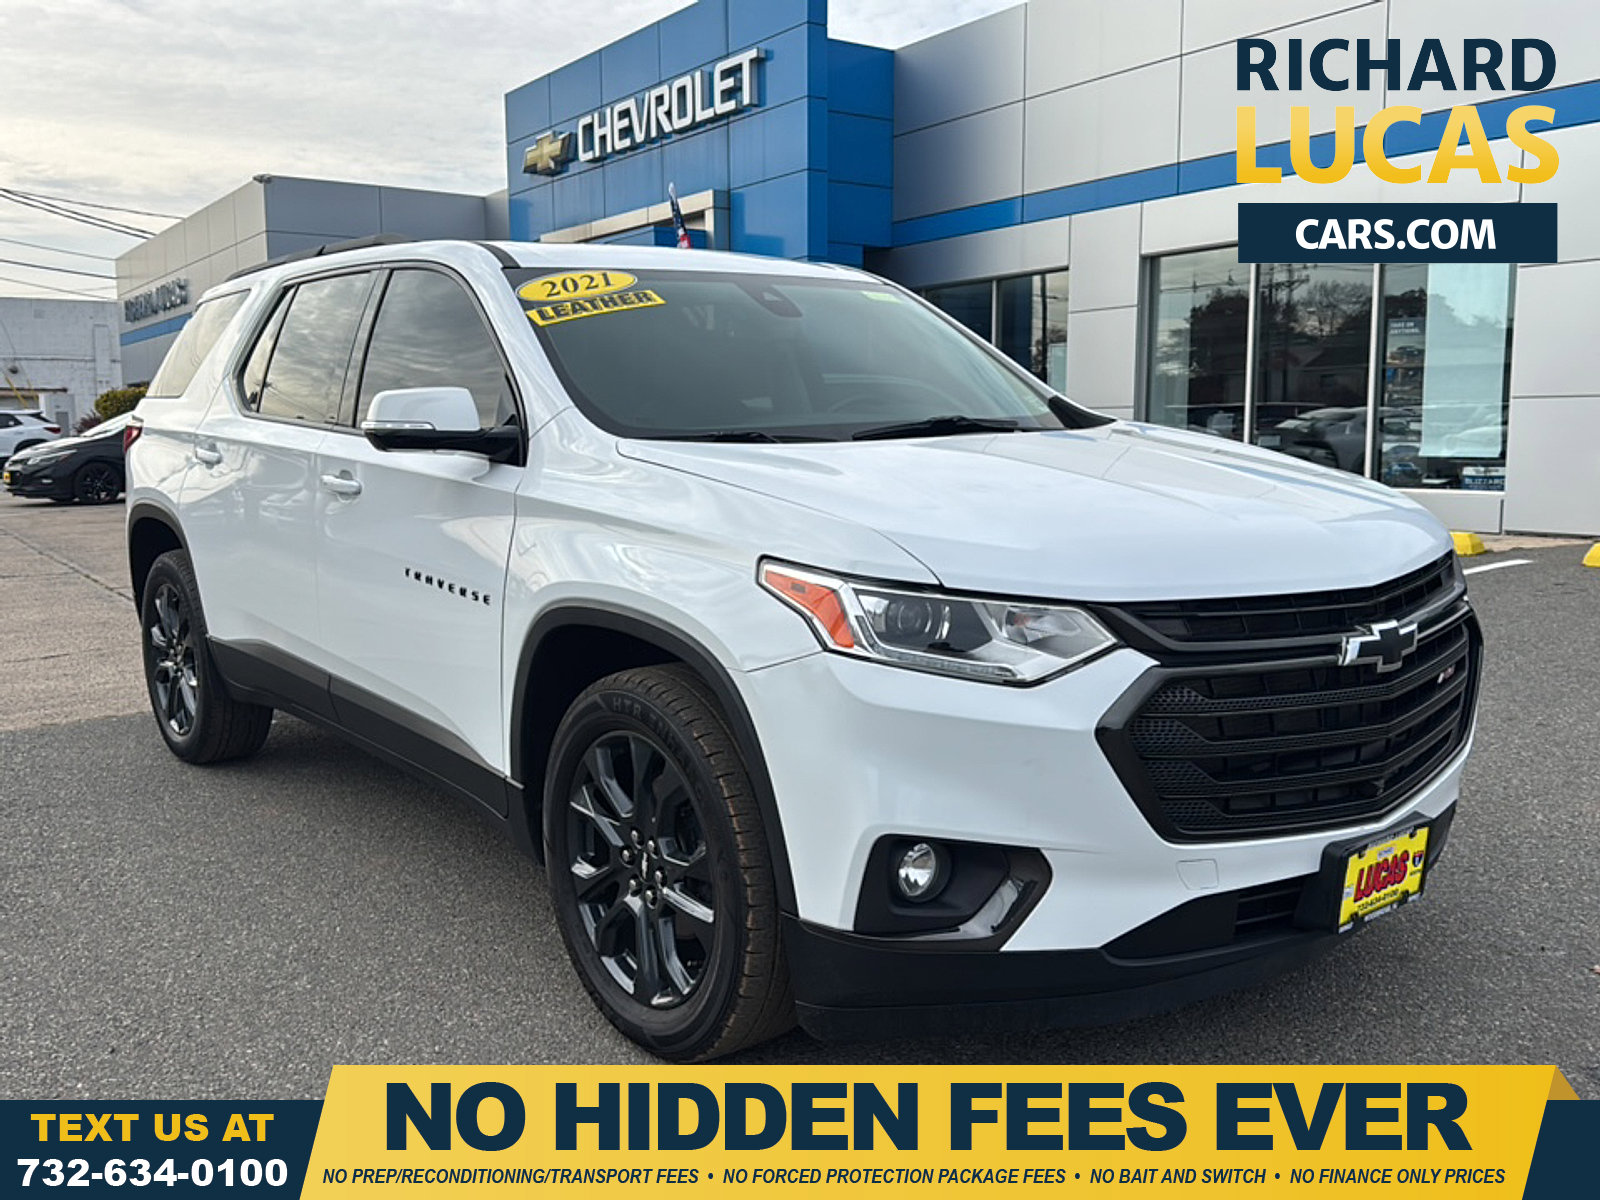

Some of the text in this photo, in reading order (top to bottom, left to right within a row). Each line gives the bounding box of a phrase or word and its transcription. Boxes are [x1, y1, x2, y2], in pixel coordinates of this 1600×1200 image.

[577, 47, 762, 162] CHEVROLET
[541, 271, 616, 298] 2021
[536, 290, 658, 321] LEATHER
[405, 567, 491, 606] TRAVERSE
[1354, 850, 1409, 902] LUCAS
